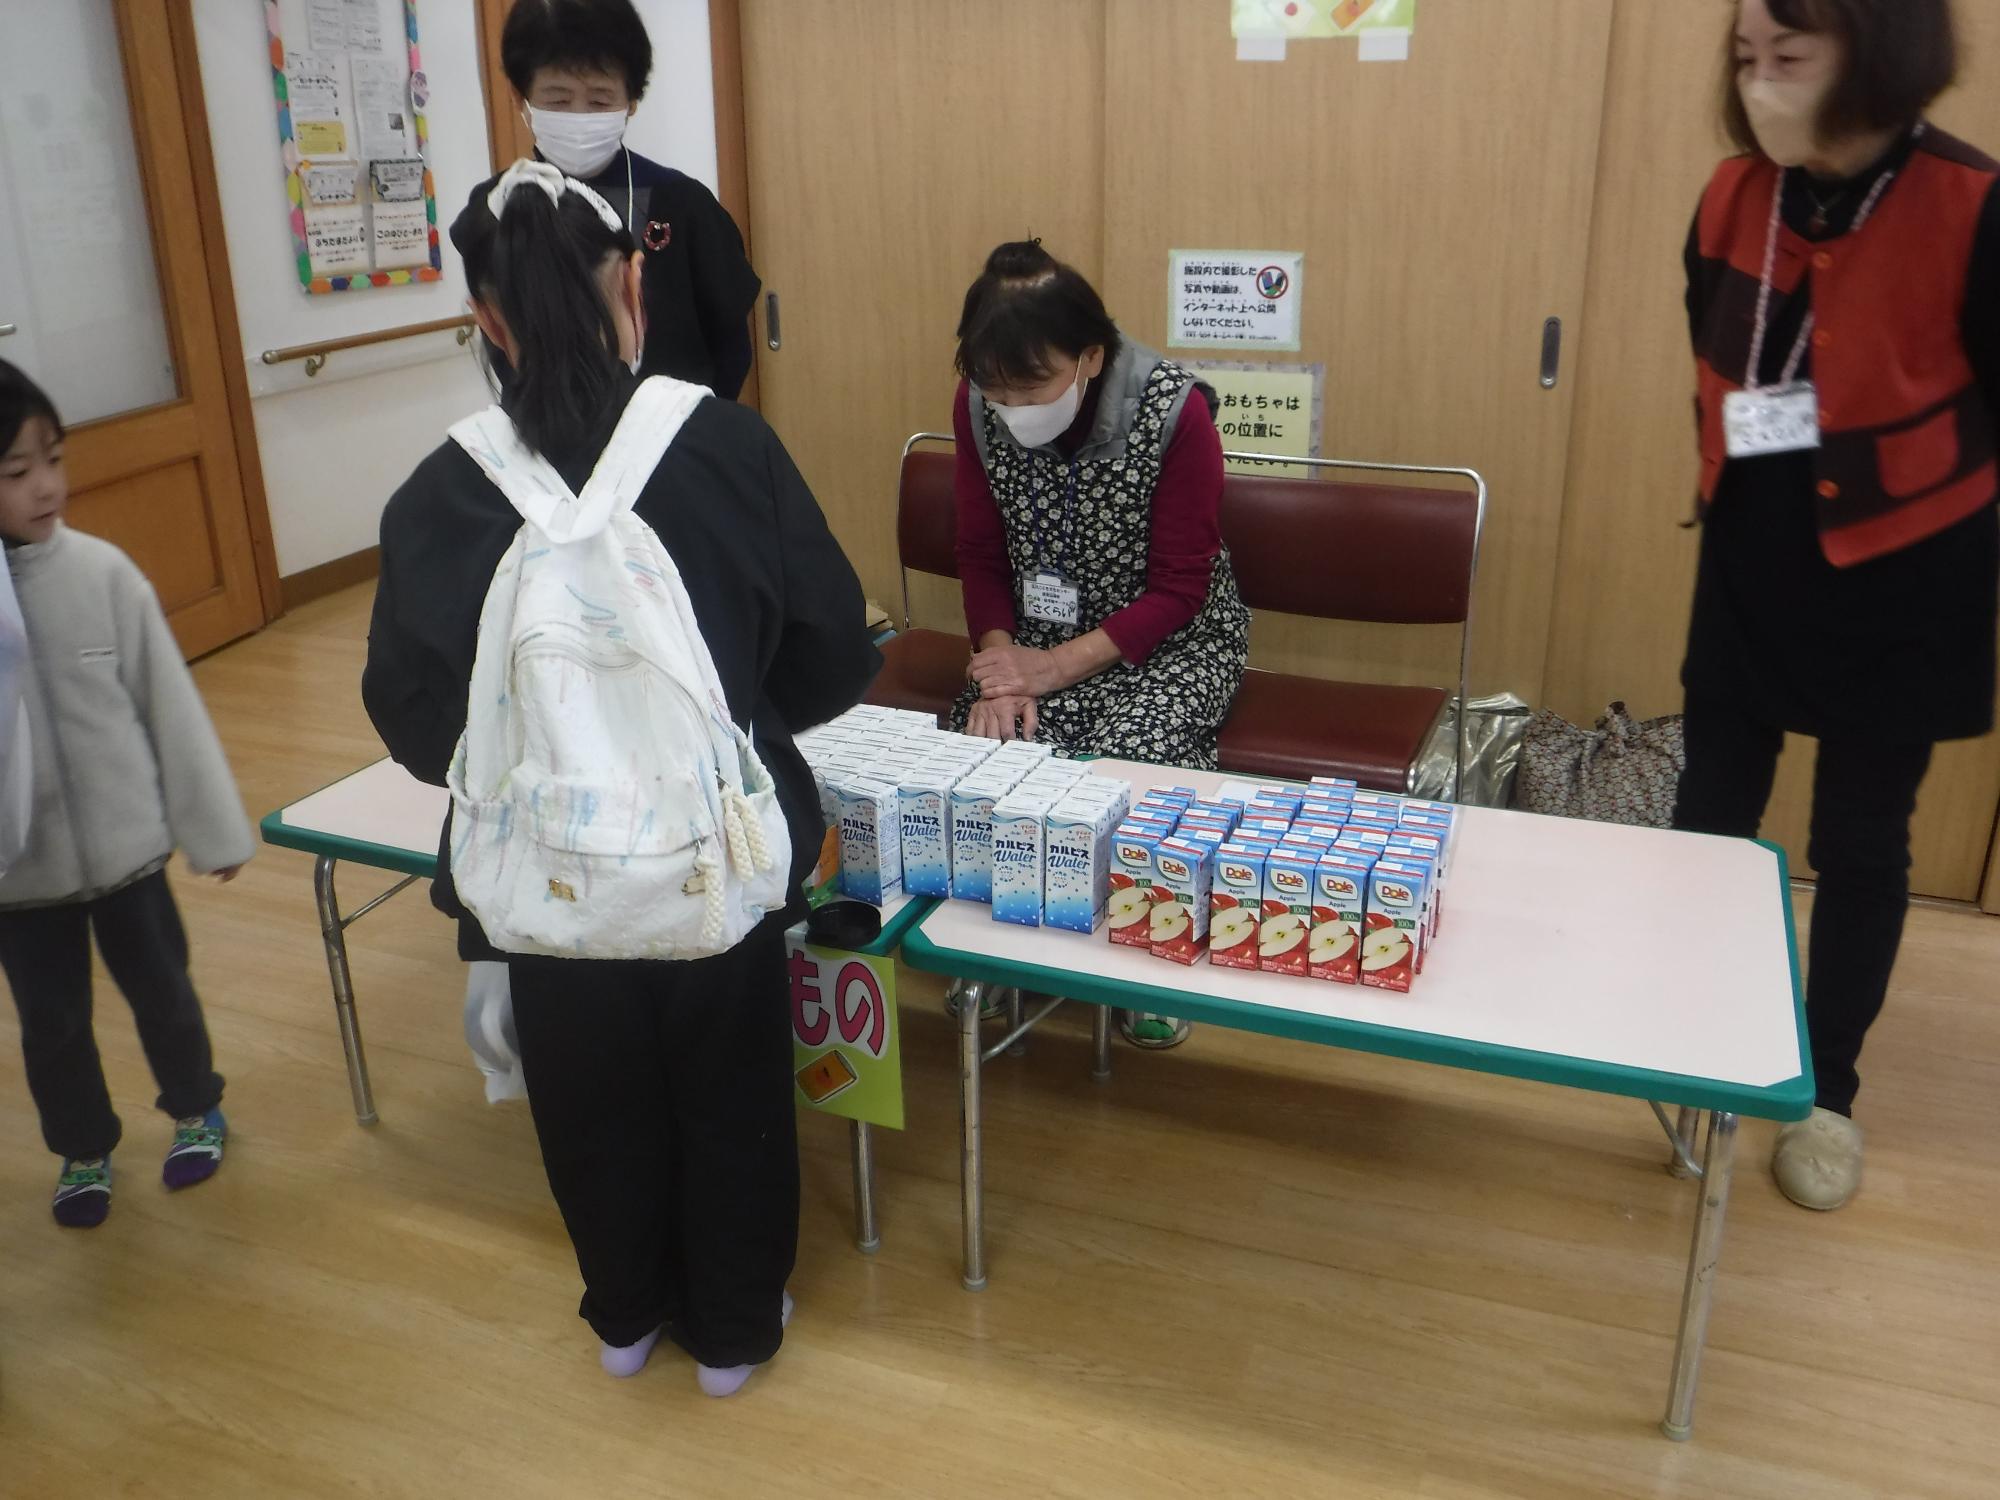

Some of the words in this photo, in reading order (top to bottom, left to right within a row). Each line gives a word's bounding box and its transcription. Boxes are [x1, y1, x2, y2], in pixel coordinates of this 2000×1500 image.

[1184, 266, 1257, 276] 施設内で撮影した
[1183, 303, 1277, 314] インターネット上へ公開
[1183, 318, 1255, 328] しないでください。
[1217, 394, 1300, 410] おもちゃは
[1215, 422, 1283, 437] の位置に
[843, 818, 876, 835] カルピス
[902, 814, 941, 826] カルピス
[955, 819, 993, 831] カルピス
[842, 828, 877, 843] Water
[902, 825, 941, 836] Water
[995, 840, 1036, 853] カルピス
[1050, 844, 1089, 859] カルピス
[994, 850, 1036, 862] Water
[1122, 847, 1147, 861] Dole
[1048, 855, 1090, 869] Water
[1163, 860, 1186, 876] Dole
[1226, 867, 1252, 880] Dole
[1276, 873, 1304, 887] Dole
[1165, 882, 1181, 890] Apple
[1327, 879, 1354, 891] Dole
[1279, 894, 1296, 902] Apple
[1381, 886, 1410, 900] Dole
[1383, 908, 1401, 916] Apple
[785, 948, 885, 1056] もの
